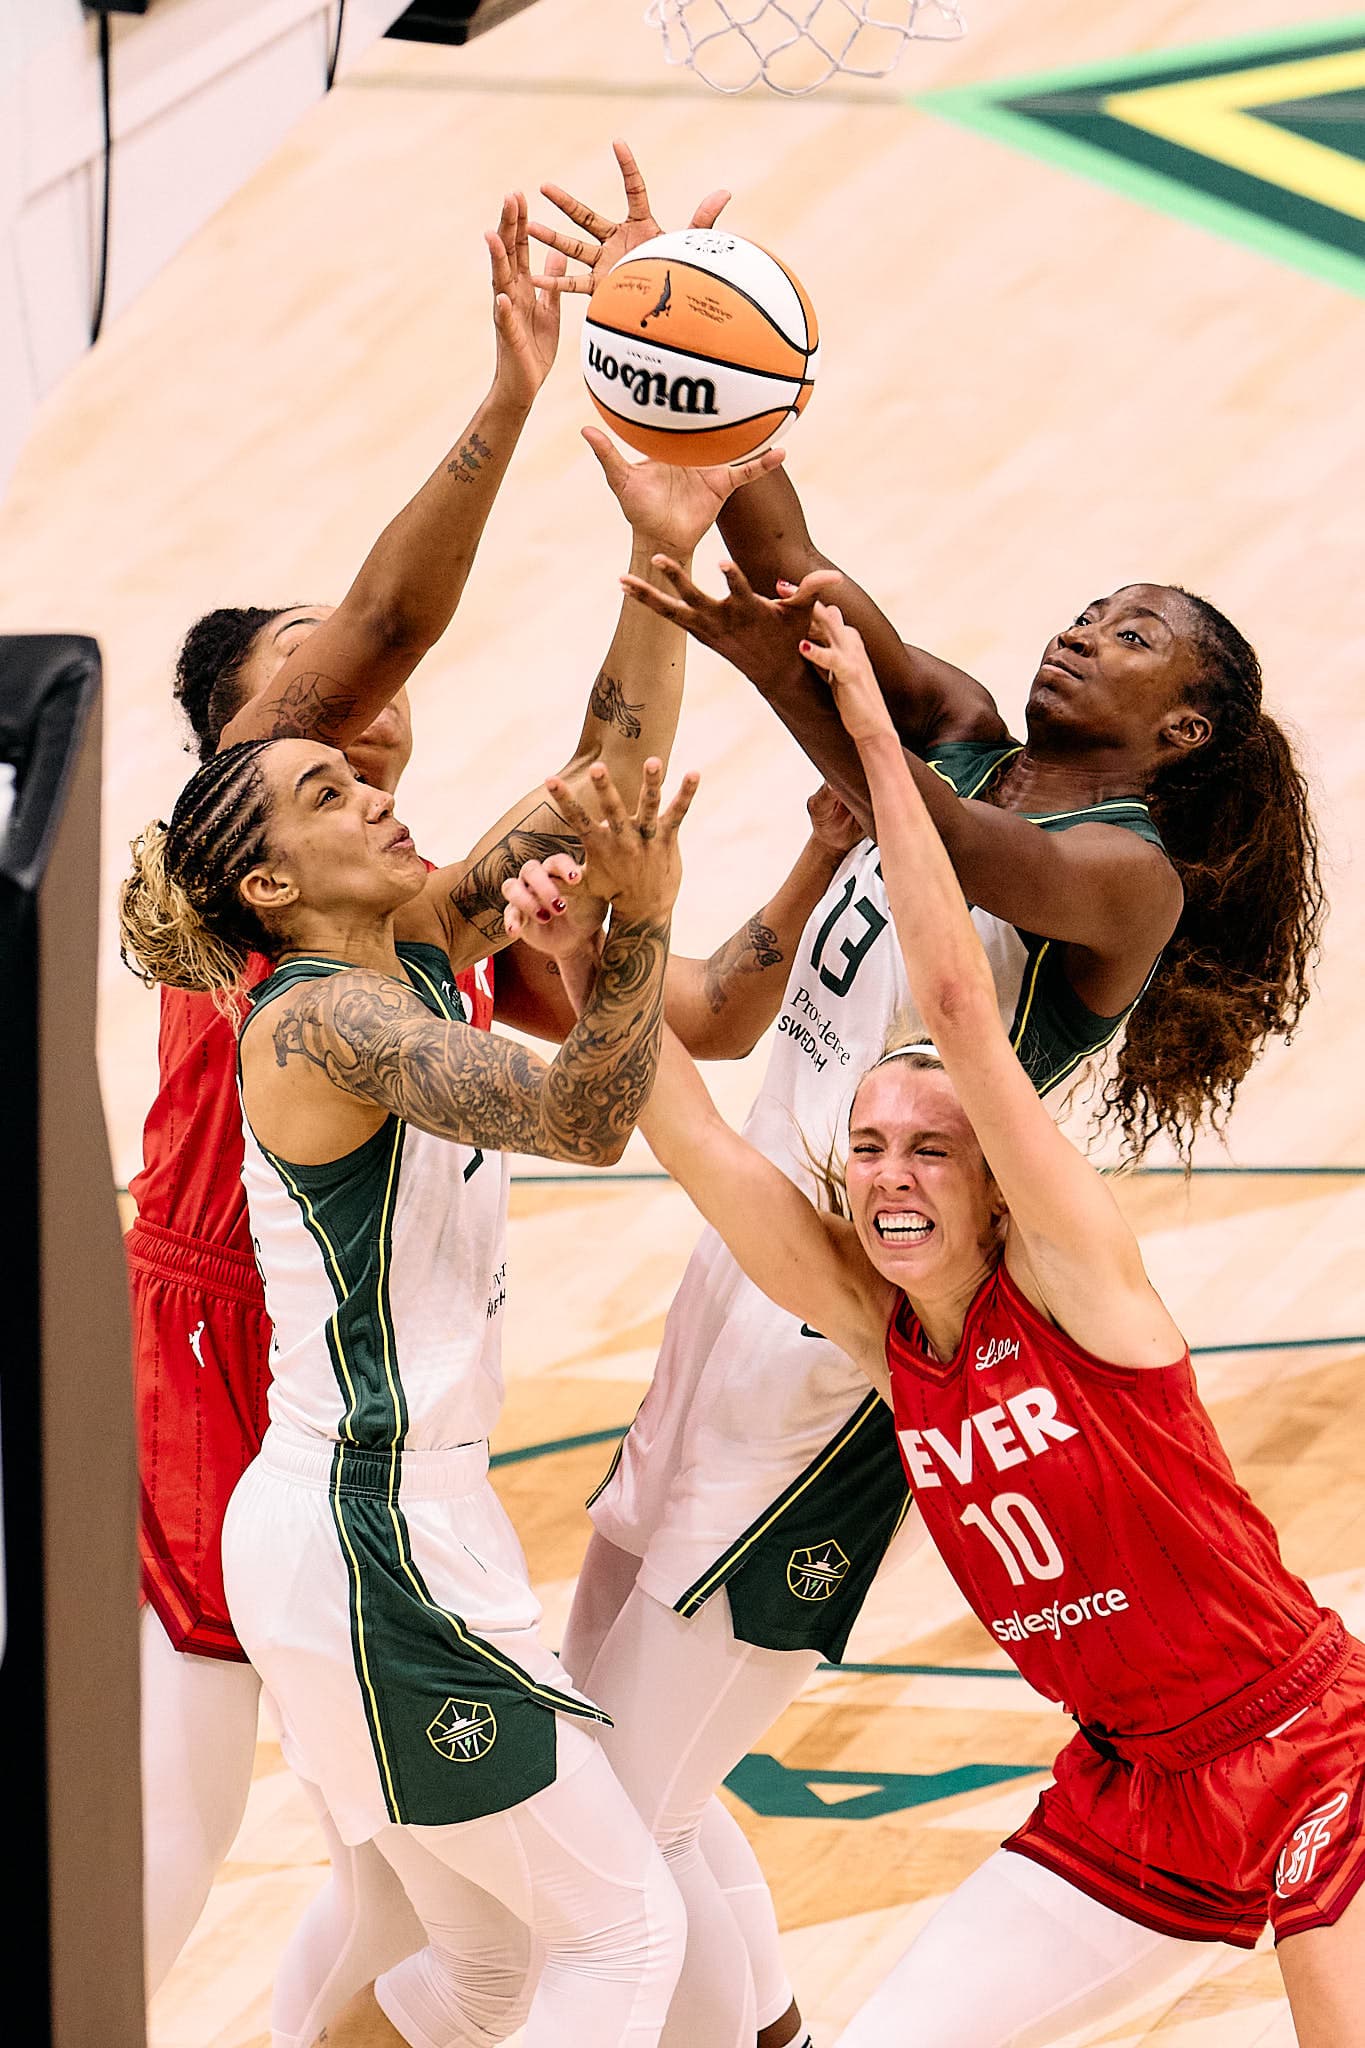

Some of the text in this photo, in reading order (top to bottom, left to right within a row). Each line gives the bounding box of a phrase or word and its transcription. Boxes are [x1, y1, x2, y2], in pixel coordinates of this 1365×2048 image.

[588, 339, 719, 415] Wilson
[810, 875, 889, 998] 13
[975, 1337, 1020, 1371] Lilly
[898, 1387, 1079, 1489] EVER
[959, 1492, 1065, 1586] 10
[992, 1588, 1130, 1641] salesforce
